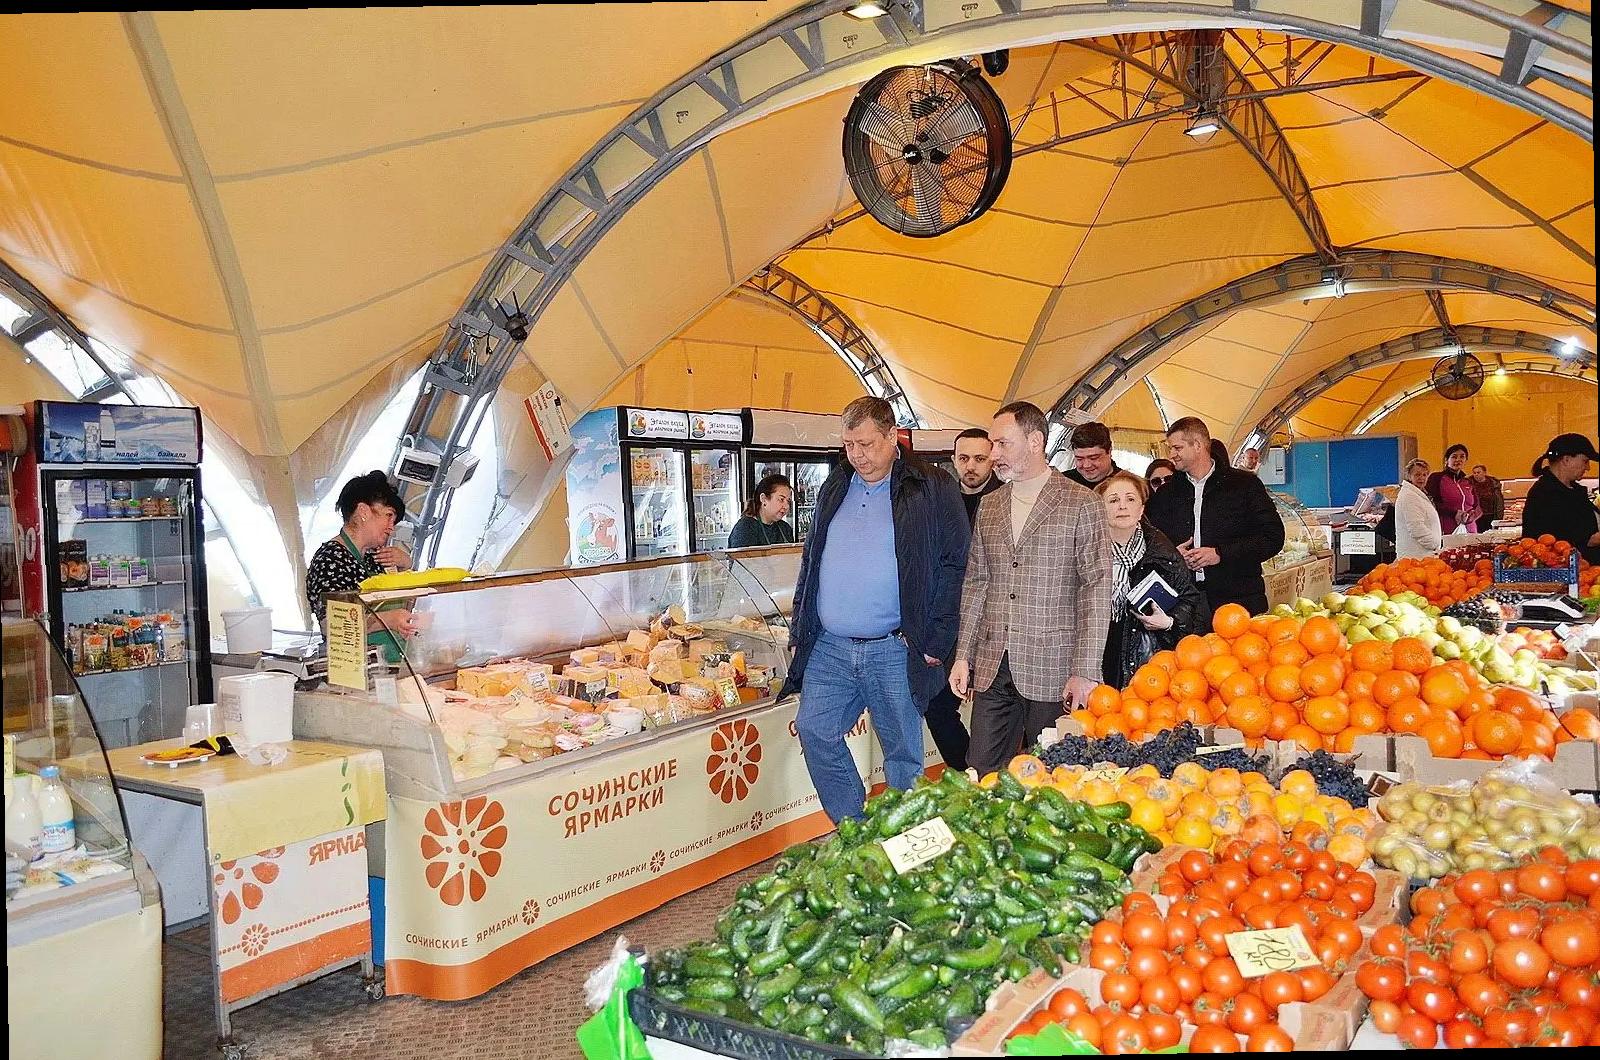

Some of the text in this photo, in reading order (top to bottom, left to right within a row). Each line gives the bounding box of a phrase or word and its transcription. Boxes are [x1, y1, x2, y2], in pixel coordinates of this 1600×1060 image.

[548, 758, 677, 816] СОЧИНСКИЕ
[564, 786, 664, 838] ЯРМАРКИ
[904, 827, 941, 859] 250
[405, 799, 801, 949] СОЧИНСКИЕ ЯРМАРКИ СОЧИНСКИЕ ЯРМАРКИ СОЧИНСКИЕ ЯРМАРКИ СОЧИНСКИЕ
[1253, 933, 1296, 970] 180
